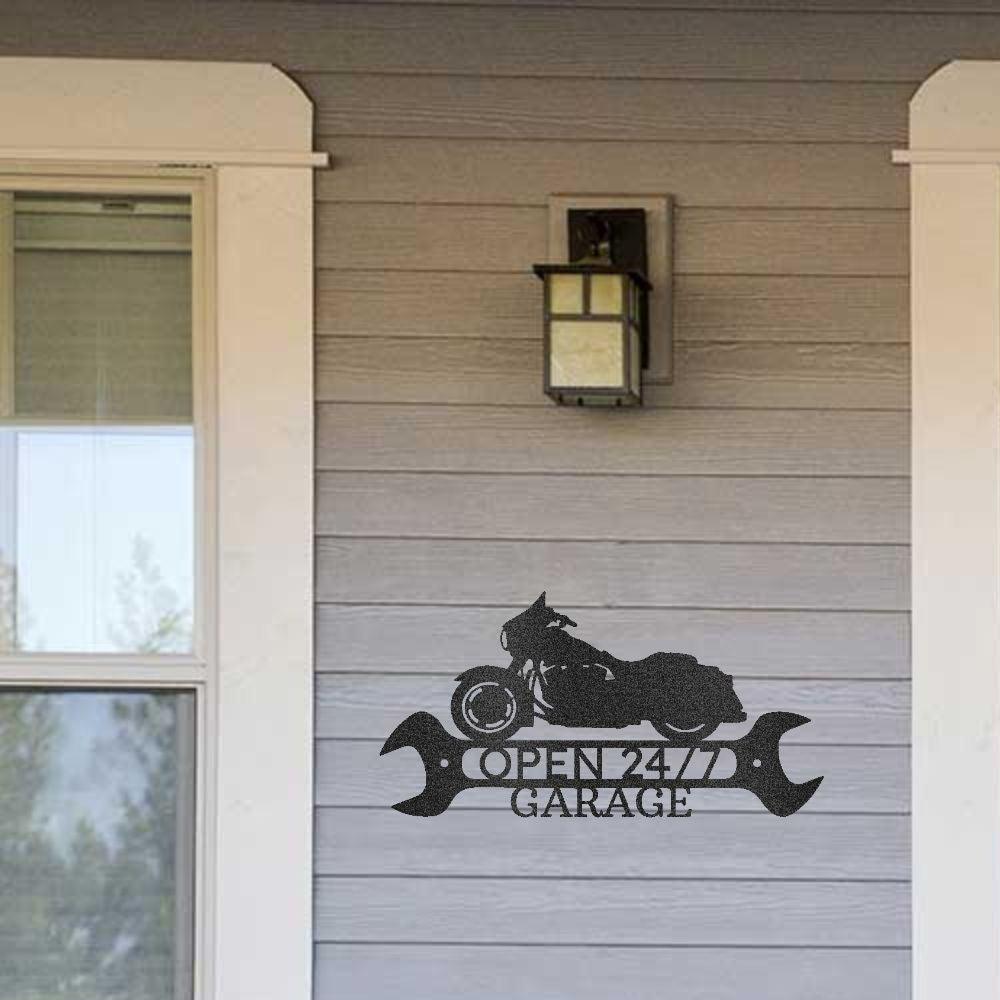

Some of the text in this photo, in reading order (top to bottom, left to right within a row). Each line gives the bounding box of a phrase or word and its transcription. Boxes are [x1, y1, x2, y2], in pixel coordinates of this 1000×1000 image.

[479, 747, 721, 780] OPEN 24/7
[510, 786, 692, 818] GARAGE
